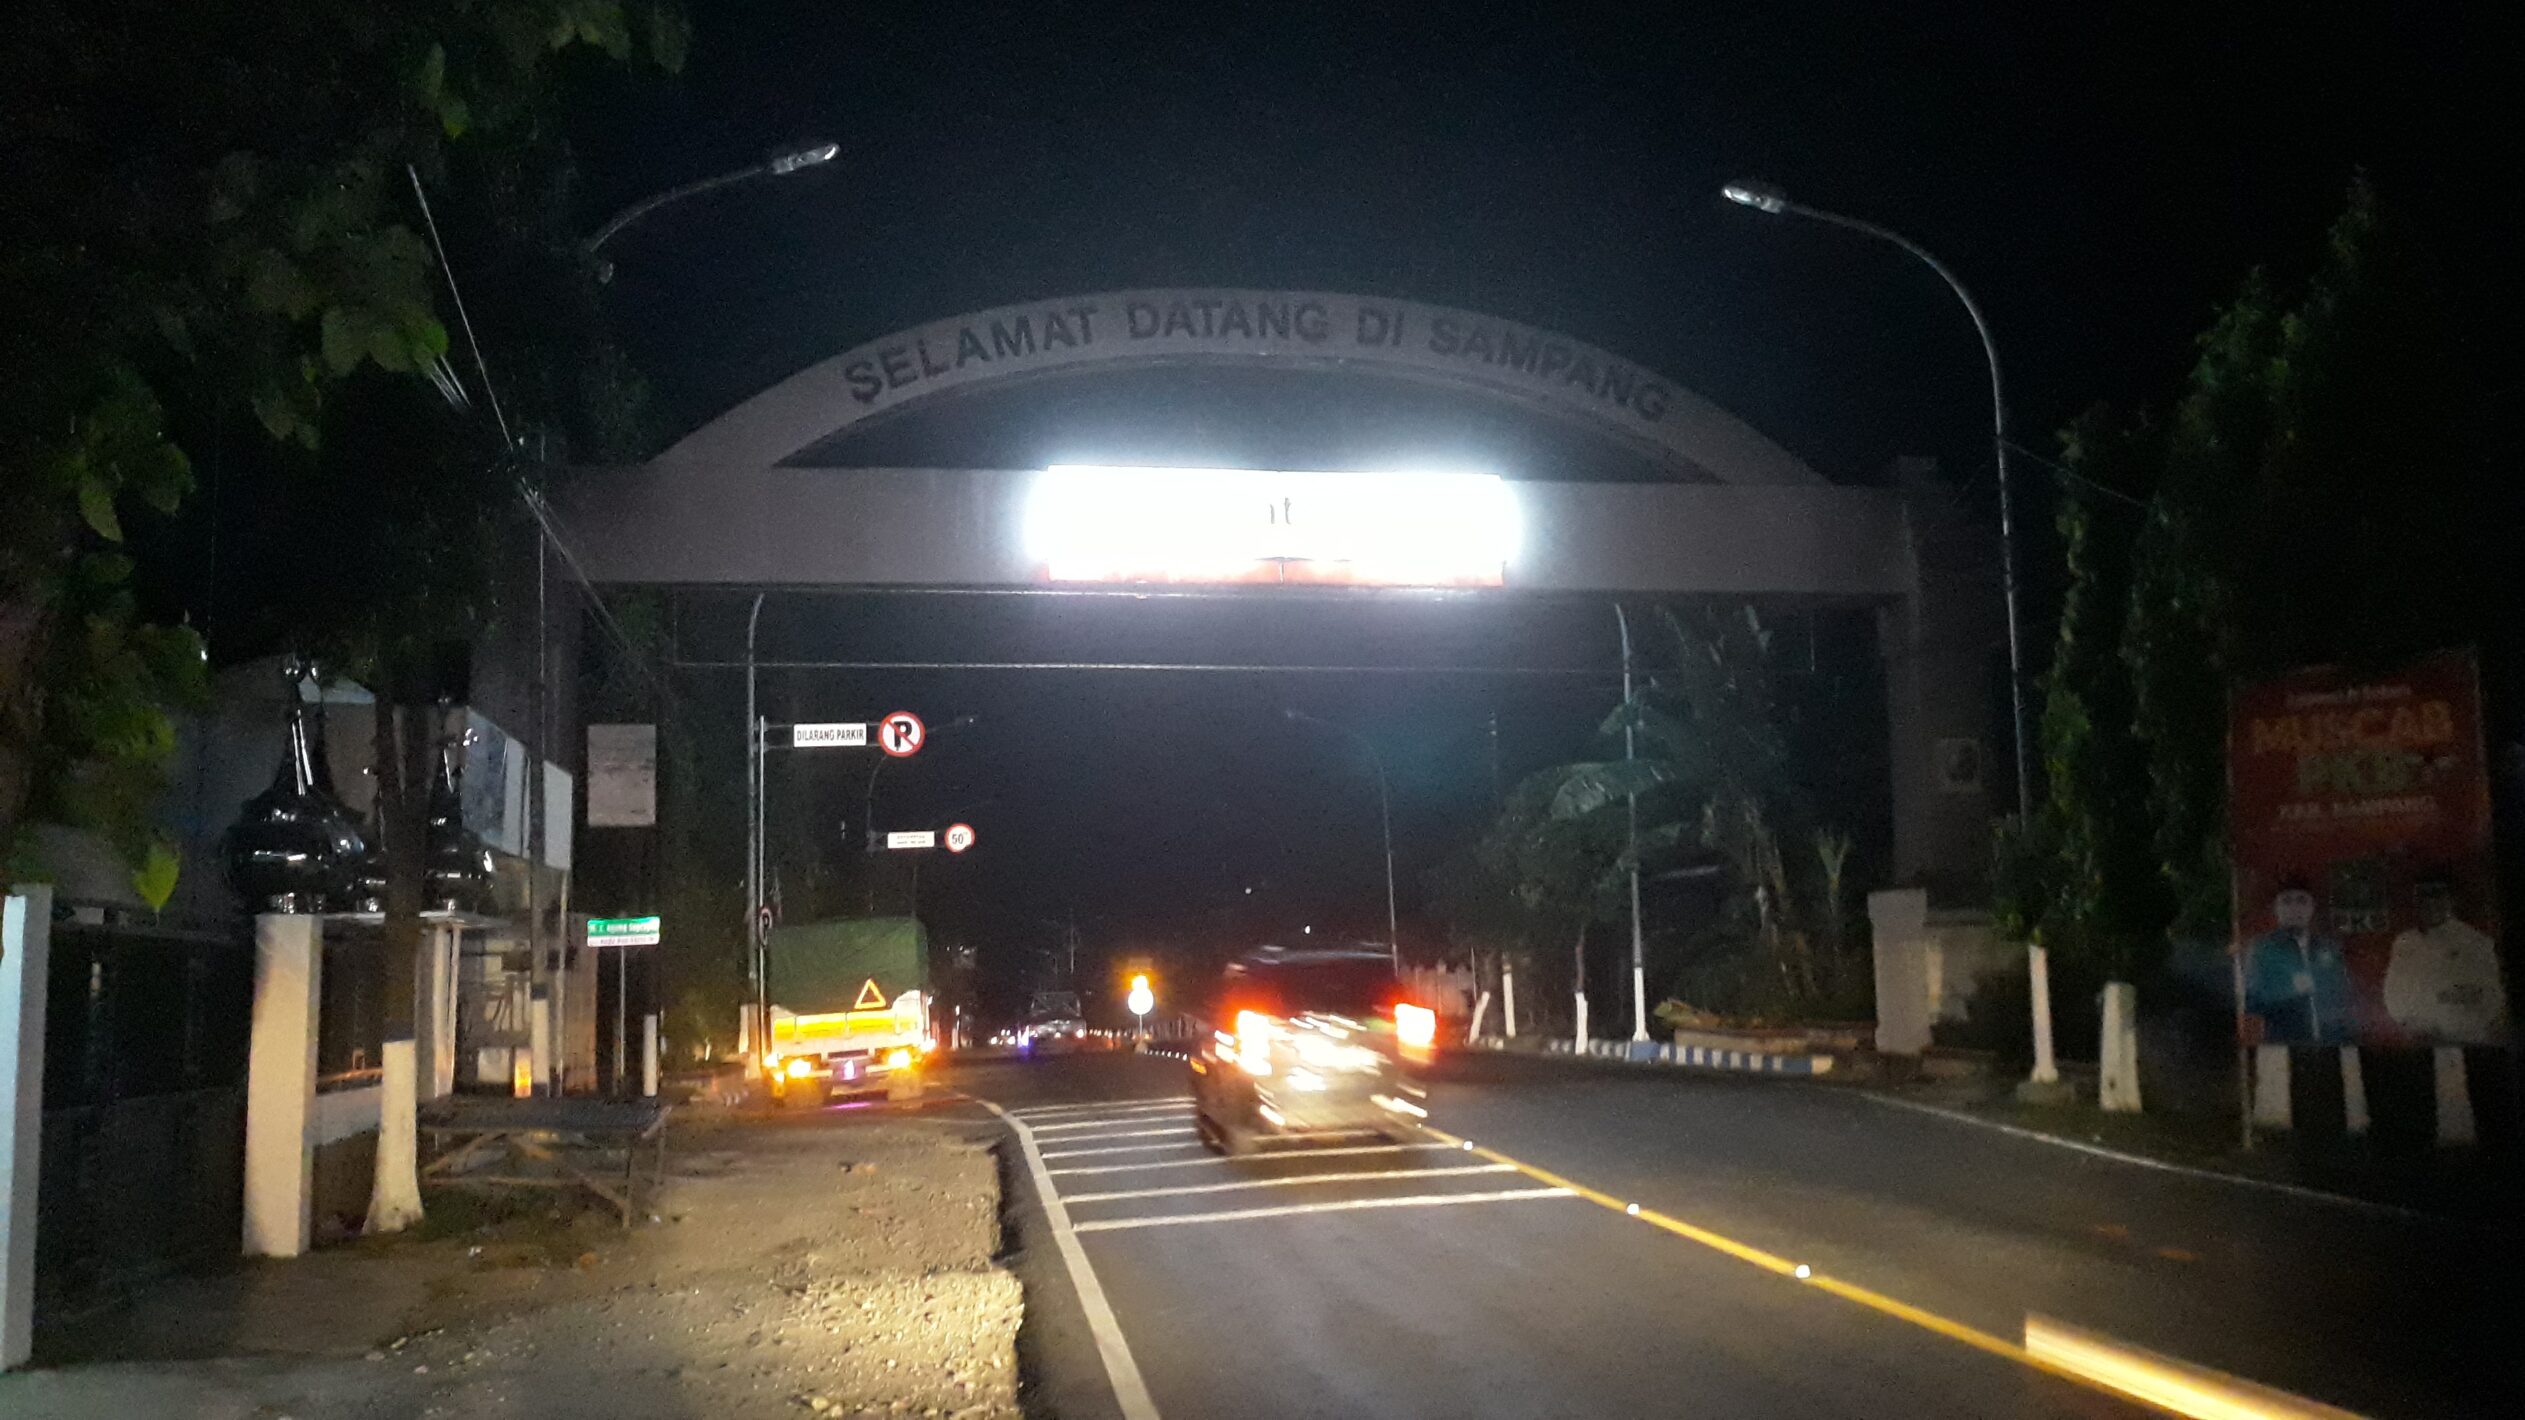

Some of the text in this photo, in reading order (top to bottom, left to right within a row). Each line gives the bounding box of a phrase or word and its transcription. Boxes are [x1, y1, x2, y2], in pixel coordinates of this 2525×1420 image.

[843, 300, 1671, 422] SELAMAT DATANG DI SAMPANG
[797, 728, 864, 743] DILARANG PARKIR
[894, 721, 912, 751] P
[951, 833, 964, 845] 50
